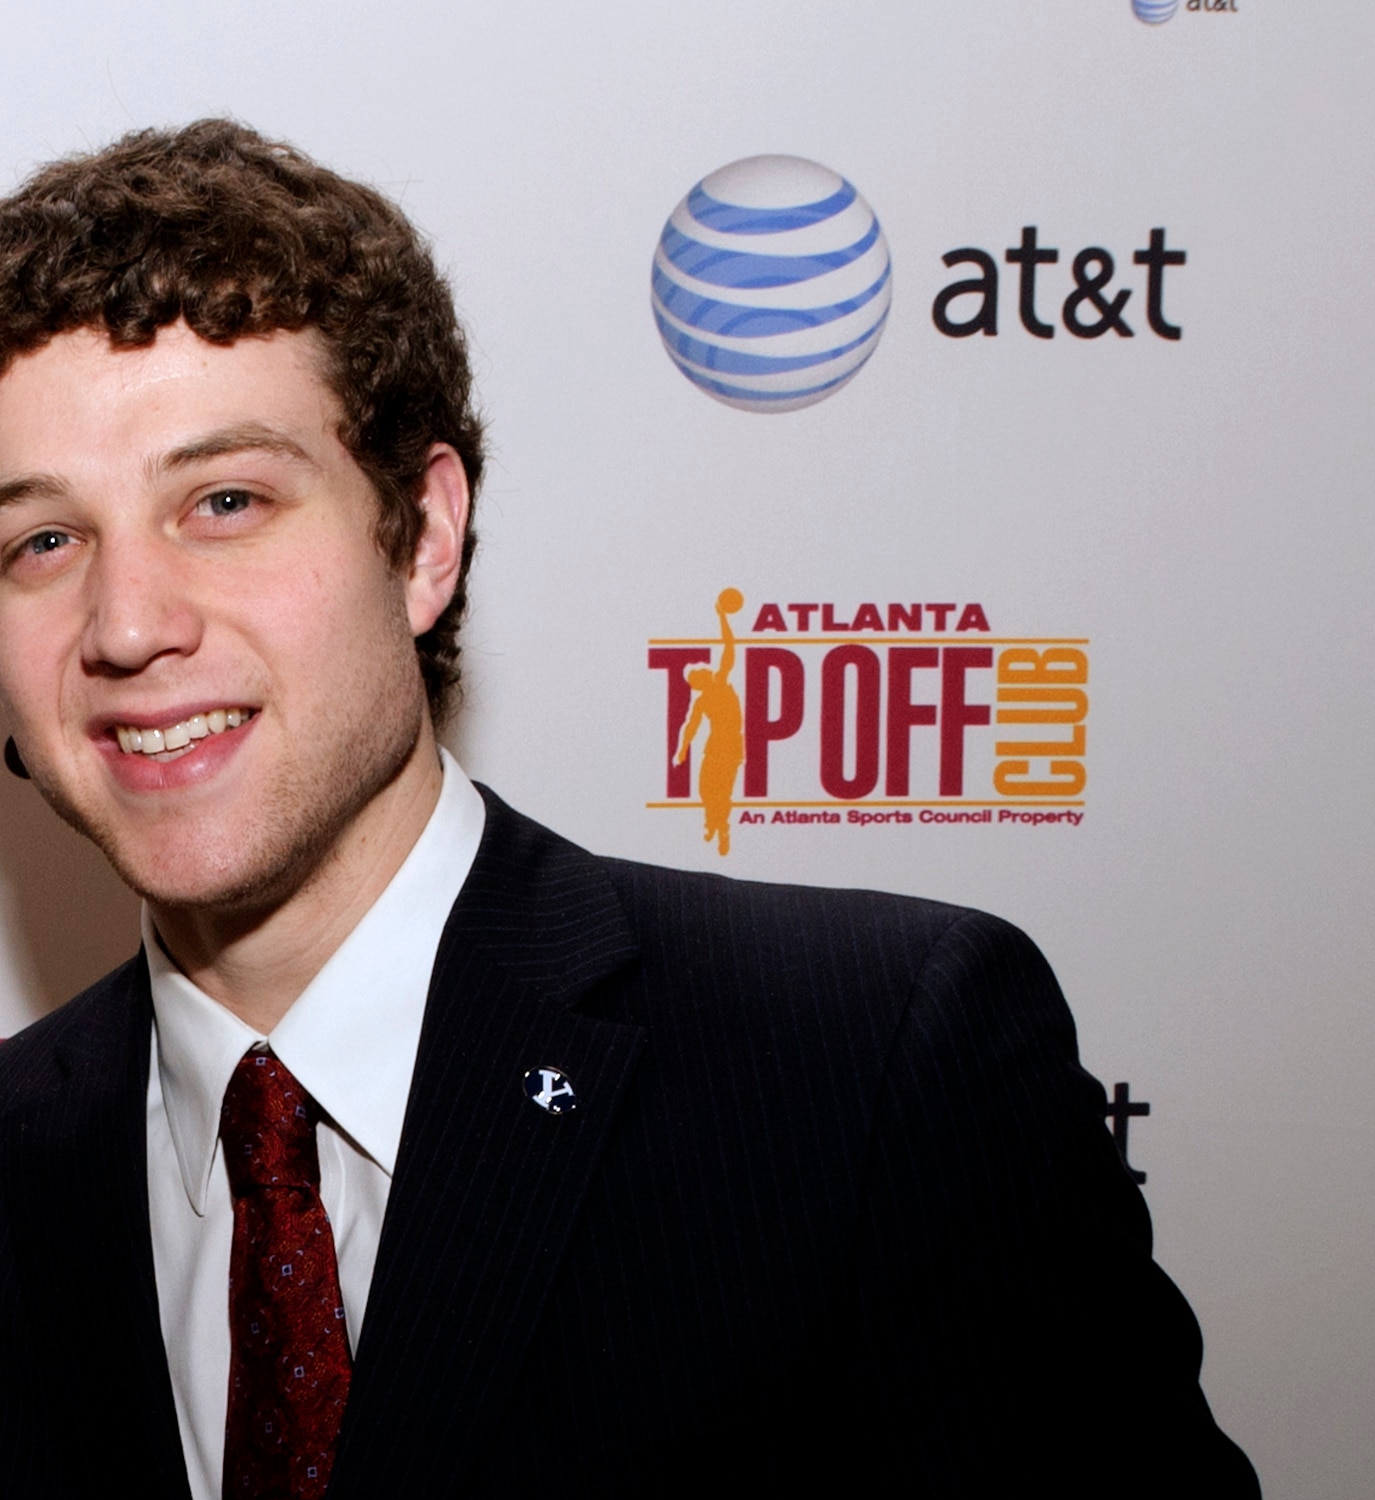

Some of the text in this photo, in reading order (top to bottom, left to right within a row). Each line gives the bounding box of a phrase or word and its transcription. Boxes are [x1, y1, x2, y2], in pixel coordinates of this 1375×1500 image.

[931, 226, 1187, 341] at&t
[751, 603, 990, 632] ATLANTA
[993, 646, 1089, 797] CLUB
[739, 809, 1084, 827] An Atlanta Sports Council Property
